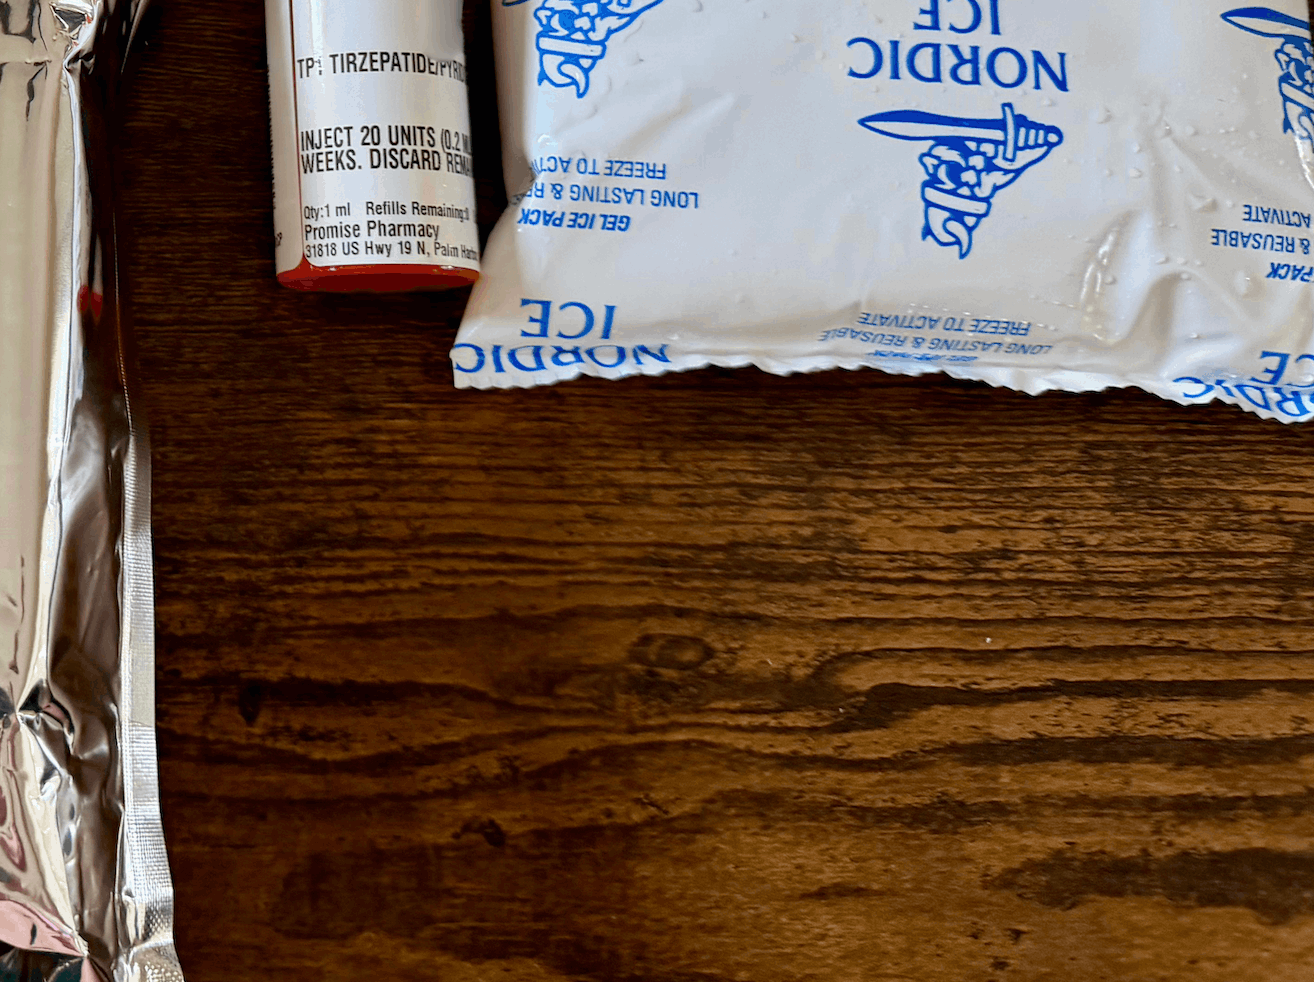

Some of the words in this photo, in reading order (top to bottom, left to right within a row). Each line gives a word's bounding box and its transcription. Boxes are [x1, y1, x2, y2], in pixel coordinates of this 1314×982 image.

[846, 36, 1070, 93] NORDIC
[301, 126, 353, 151] INJECT
[360, 125, 381, 146] 20
[388, 124, 436, 148] UNITS
[440, 128, 461, 153] (0.2
[301, 149, 362, 174] WEEKS.
[370, 148, 441, 171] DISCARD
[576, 158, 600, 175] TO
[604, 160, 667, 180] FREEZE
[549, 183, 564, 200] &
[570, 184, 644, 206] LASTING
[651, 189, 699, 209] LONG
[335, 202, 351, 217] ml
[366, 201, 406, 215] Refills
[517, 208, 565, 227] PACK
[1242, 204, 1311, 228] ACTIVATE
[566, 212, 596, 229] ICE
[600, 214, 631, 232] GEL
[304, 221, 361, 240] Promise
[367, 220, 439, 241] Pharmacy
[305, 242, 337, 258] 31818
[342, 241, 359, 256] US
[365, 240, 392, 257] Hwy
[398, 240, 412, 255] 19
[417, 240, 430, 257] N,
[434, 241, 459, 258] Palm
[1211, 228, 1295, 254] REUSABLE
[1298, 237, 1310, 255] &
[1266, 262, 1314, 284] PACK
[519, 298, 618, 340] ICE
[856, 312, 942, 330] ACTIVATE
[943, 317, 965, 331] TO
[968, 319, 1031, 336] FREEZE
[927, 338, 1003, 353] LASTING
[1004, 343, 1053, 355] LONG
[453, 343, 671, 373] NORDIC
